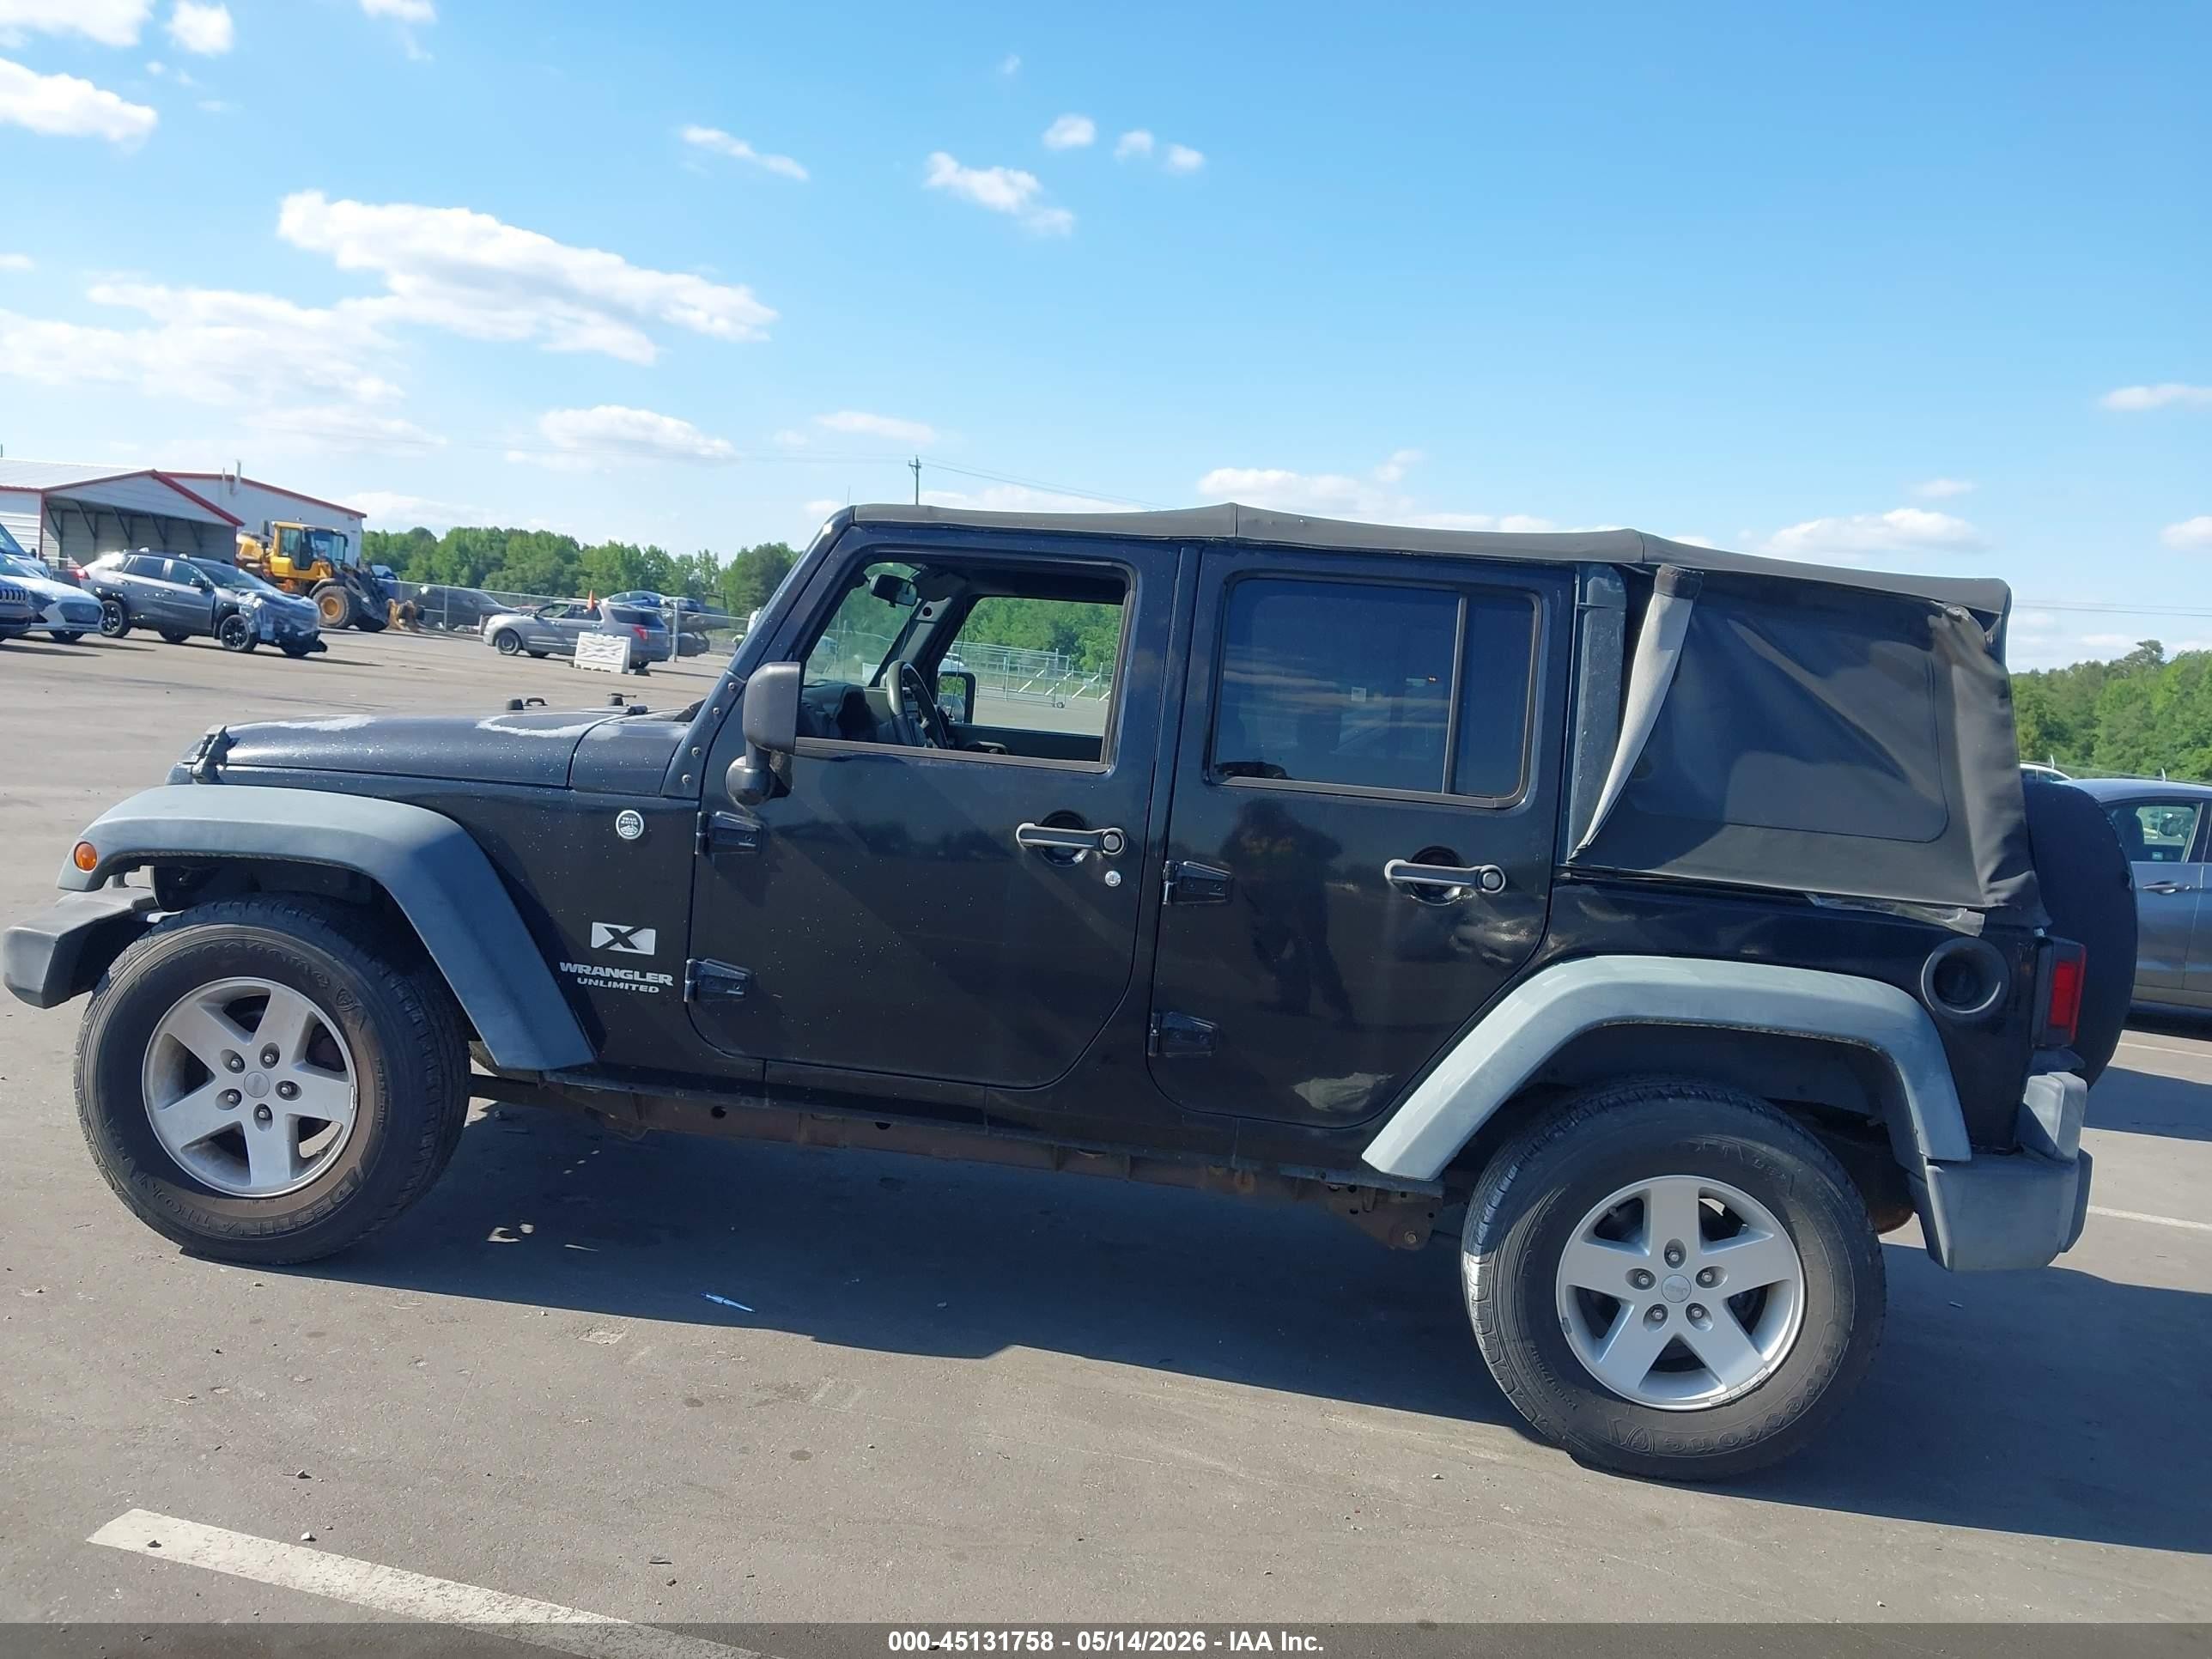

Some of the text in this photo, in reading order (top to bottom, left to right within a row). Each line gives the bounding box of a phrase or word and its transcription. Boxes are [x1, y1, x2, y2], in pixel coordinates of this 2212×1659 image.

[595, 923, 648, 953] X
[559, 961, 674, 987] WRANGLER
[577, 976, 660, 994] UNLIMITED
